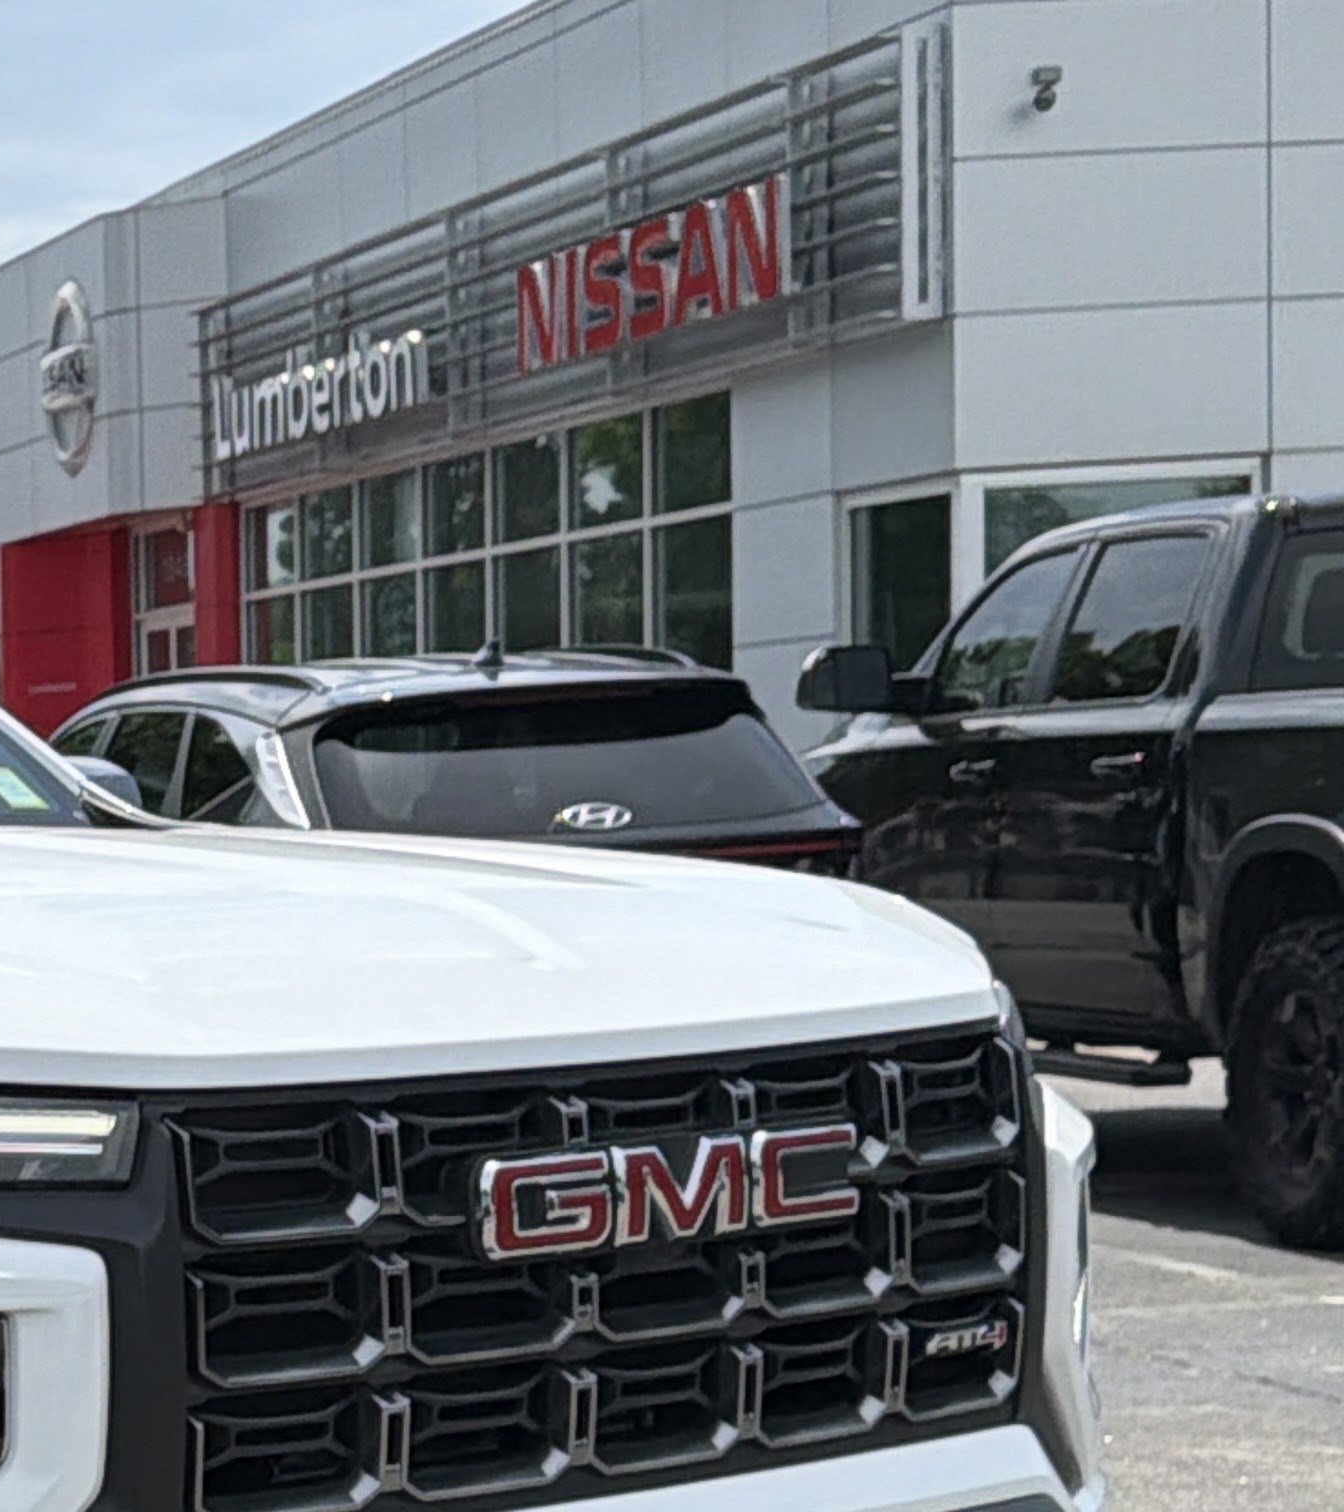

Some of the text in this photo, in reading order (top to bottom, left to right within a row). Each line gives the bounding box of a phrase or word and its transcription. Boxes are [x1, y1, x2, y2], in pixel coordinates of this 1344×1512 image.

[516, 173, 784, 379] NISSAN
[212, 332, 424, 461] Lumberton
[479, 1123, 859, 1260] GMC
[926, 1320, 1008, 1356] AT4
